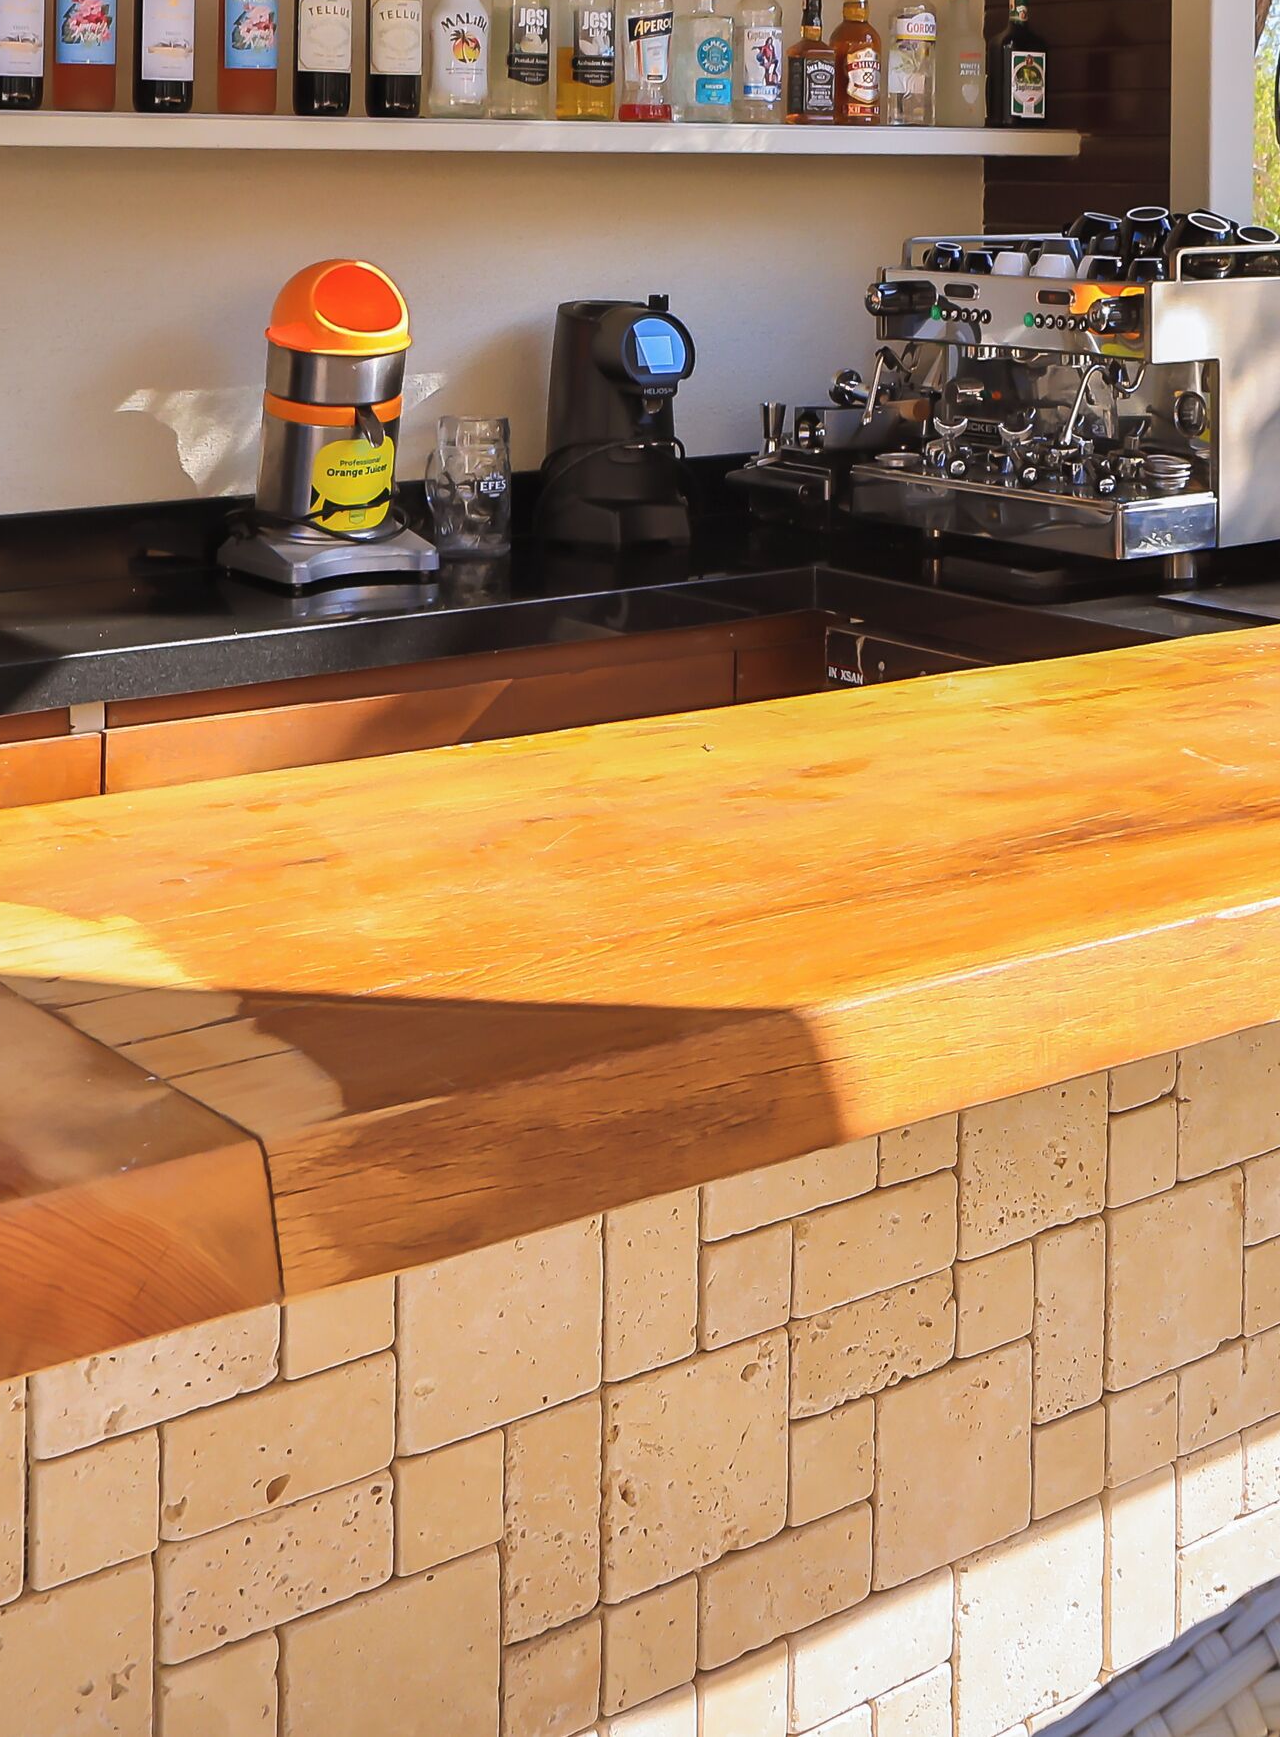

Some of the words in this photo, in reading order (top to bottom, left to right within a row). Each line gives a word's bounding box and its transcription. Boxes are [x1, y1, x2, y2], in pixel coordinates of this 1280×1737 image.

[967, 422, 998, 435] CKET
[326, 467, 363, 479] Orange
[364, 463, 388, 475] Juicer
[480, 478, 507, 492] EFES
[828, 665, 864, 686] INXSAN
